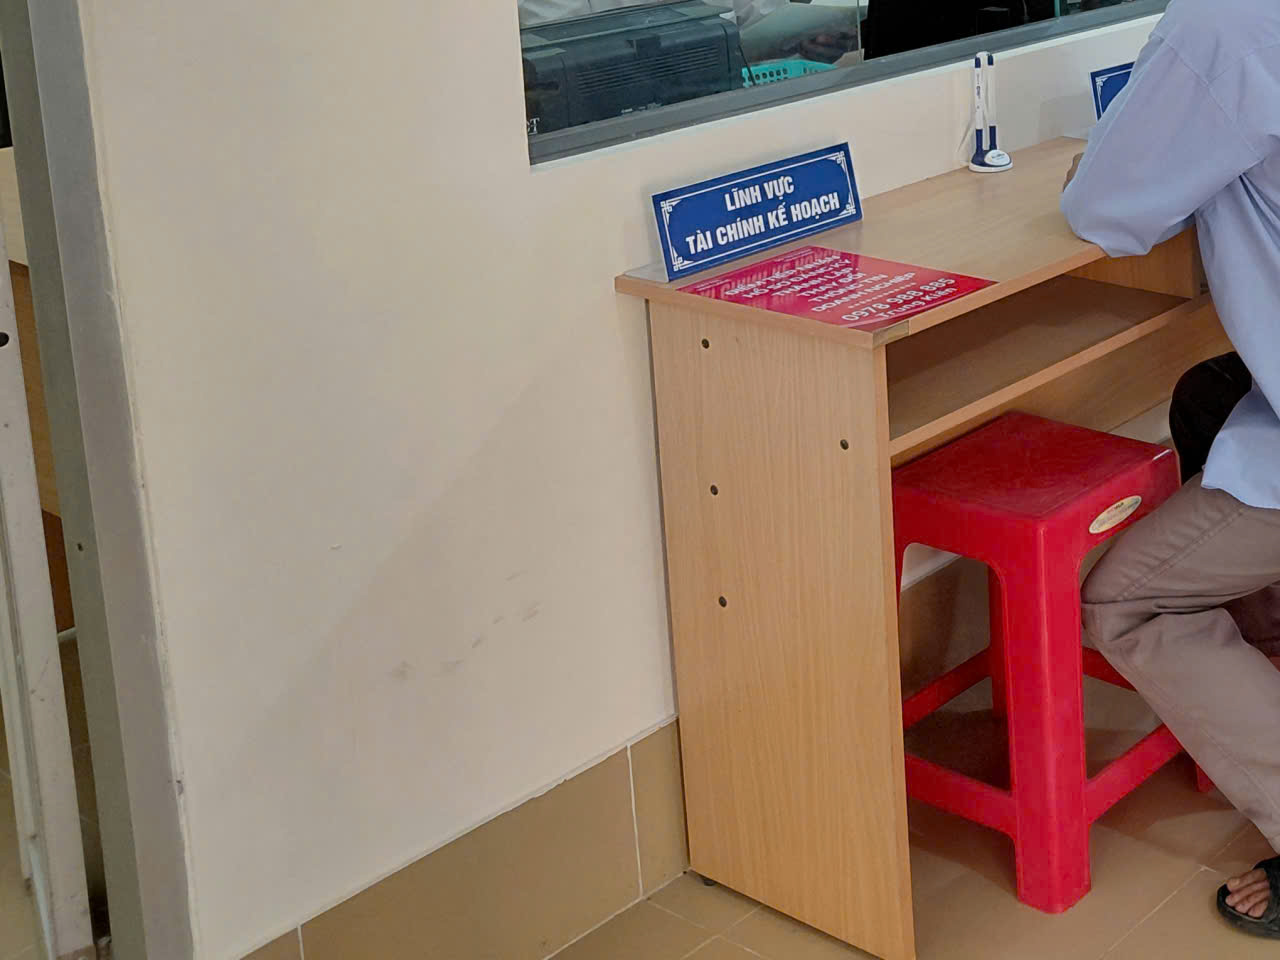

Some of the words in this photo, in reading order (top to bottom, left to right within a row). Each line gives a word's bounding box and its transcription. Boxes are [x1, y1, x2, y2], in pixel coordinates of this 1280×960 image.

[724, 188, 762, 211] LĨNH
[763, 176, 795, 201] VỰC
[685, 230, 713, 254] TÀI
[715, 214, 765, 245] CHÍNH
[767, 202, 788, 229] KẾ
[790, 191, 840, 222] HOẠCH
[842, 303, 890, 321] 0978
[886, 290, 923, 304] 988
[920, 278, 956, 291] 885
[875, 300, 926, 319] Trung
